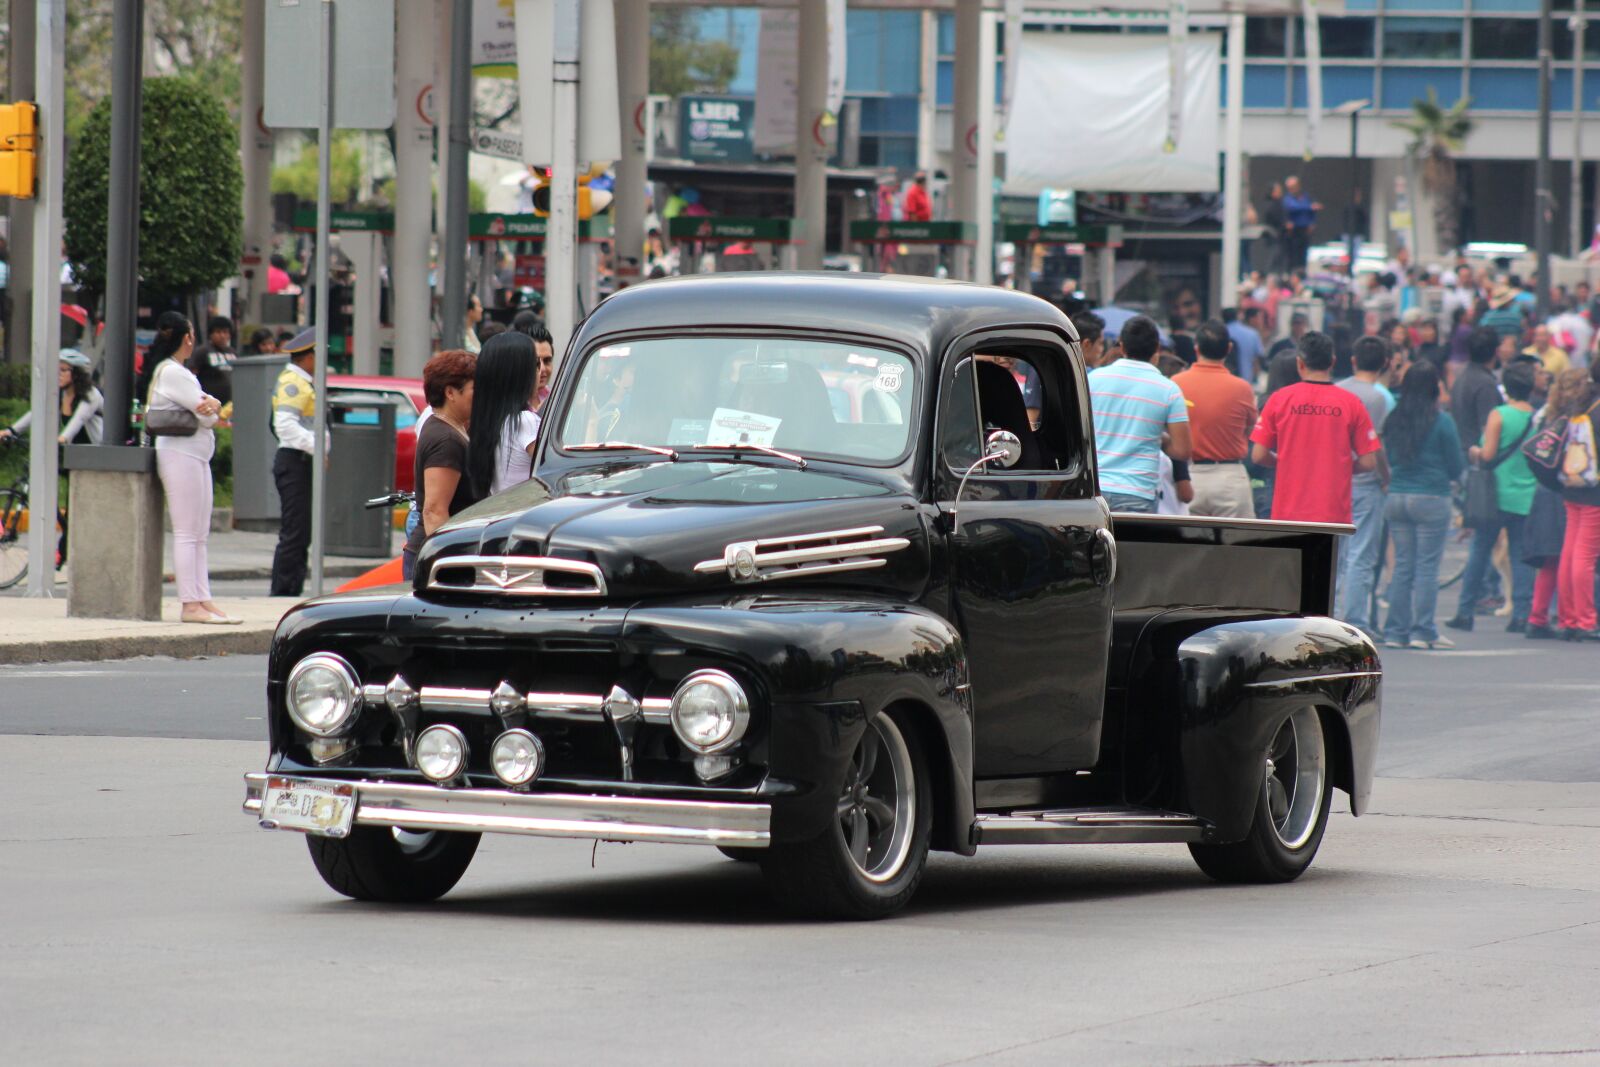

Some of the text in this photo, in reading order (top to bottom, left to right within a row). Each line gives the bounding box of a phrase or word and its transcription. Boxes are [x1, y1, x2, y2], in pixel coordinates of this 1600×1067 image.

[491, 137, 518, 154] PASEO
[333, 217, 367, 228] PEMEX
[879, 376, 897, 388] 168
[1290, 403, 1342, 417] MÉXICO
